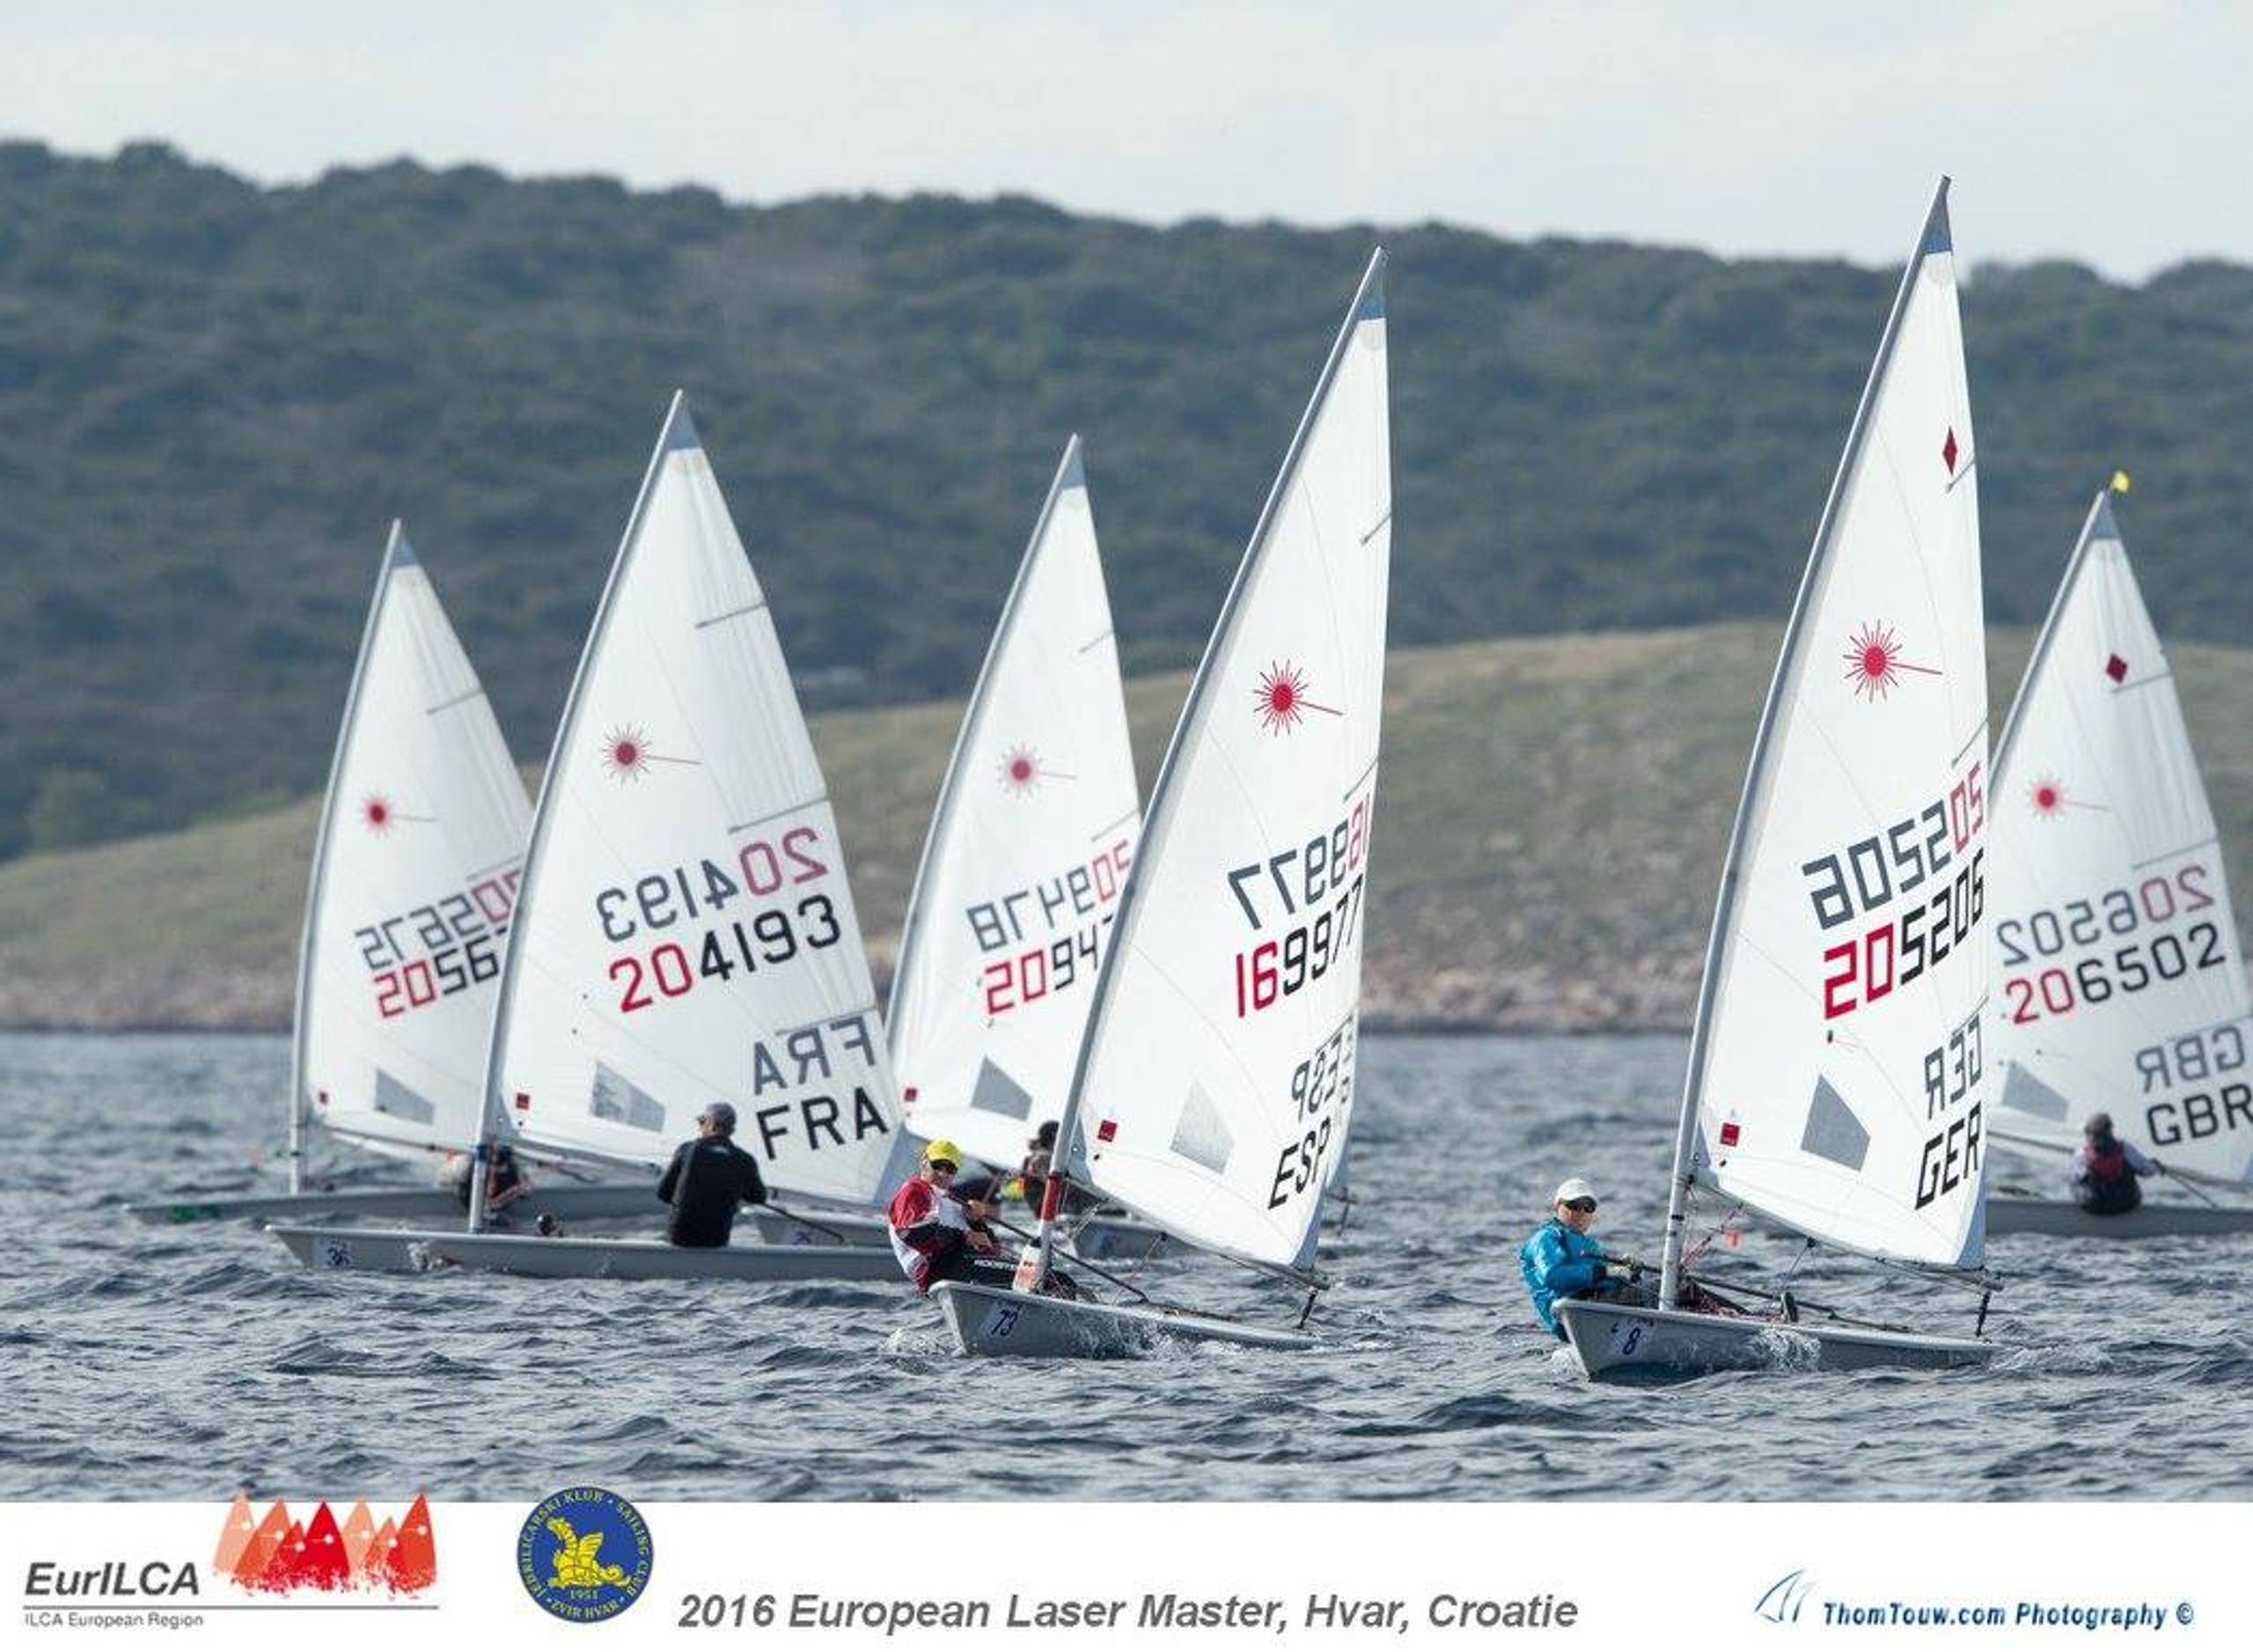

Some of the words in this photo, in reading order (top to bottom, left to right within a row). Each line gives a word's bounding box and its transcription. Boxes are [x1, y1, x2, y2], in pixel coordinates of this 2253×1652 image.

[374, 926, 508, 1018] 2056
[609, 894, 840, 1012] 204193
[984, 914, 1112, 1015] 2094
[1236, 873, 1363, 1018] 169977
[1824, 847, 1984, 1020] 205206
[2005, 922, 2226, 1024] 206502
[755, 1086, 889, 1160] FRA
[1268, 1115, 1332, 1209] ESP
[1915, 1101, 1981, 1210] GER
[2147, 1083, 2253, 1146] GBR
[991, 1310, 1018, 1336] 73
[1622, 1326, 1640, 1355] 8
